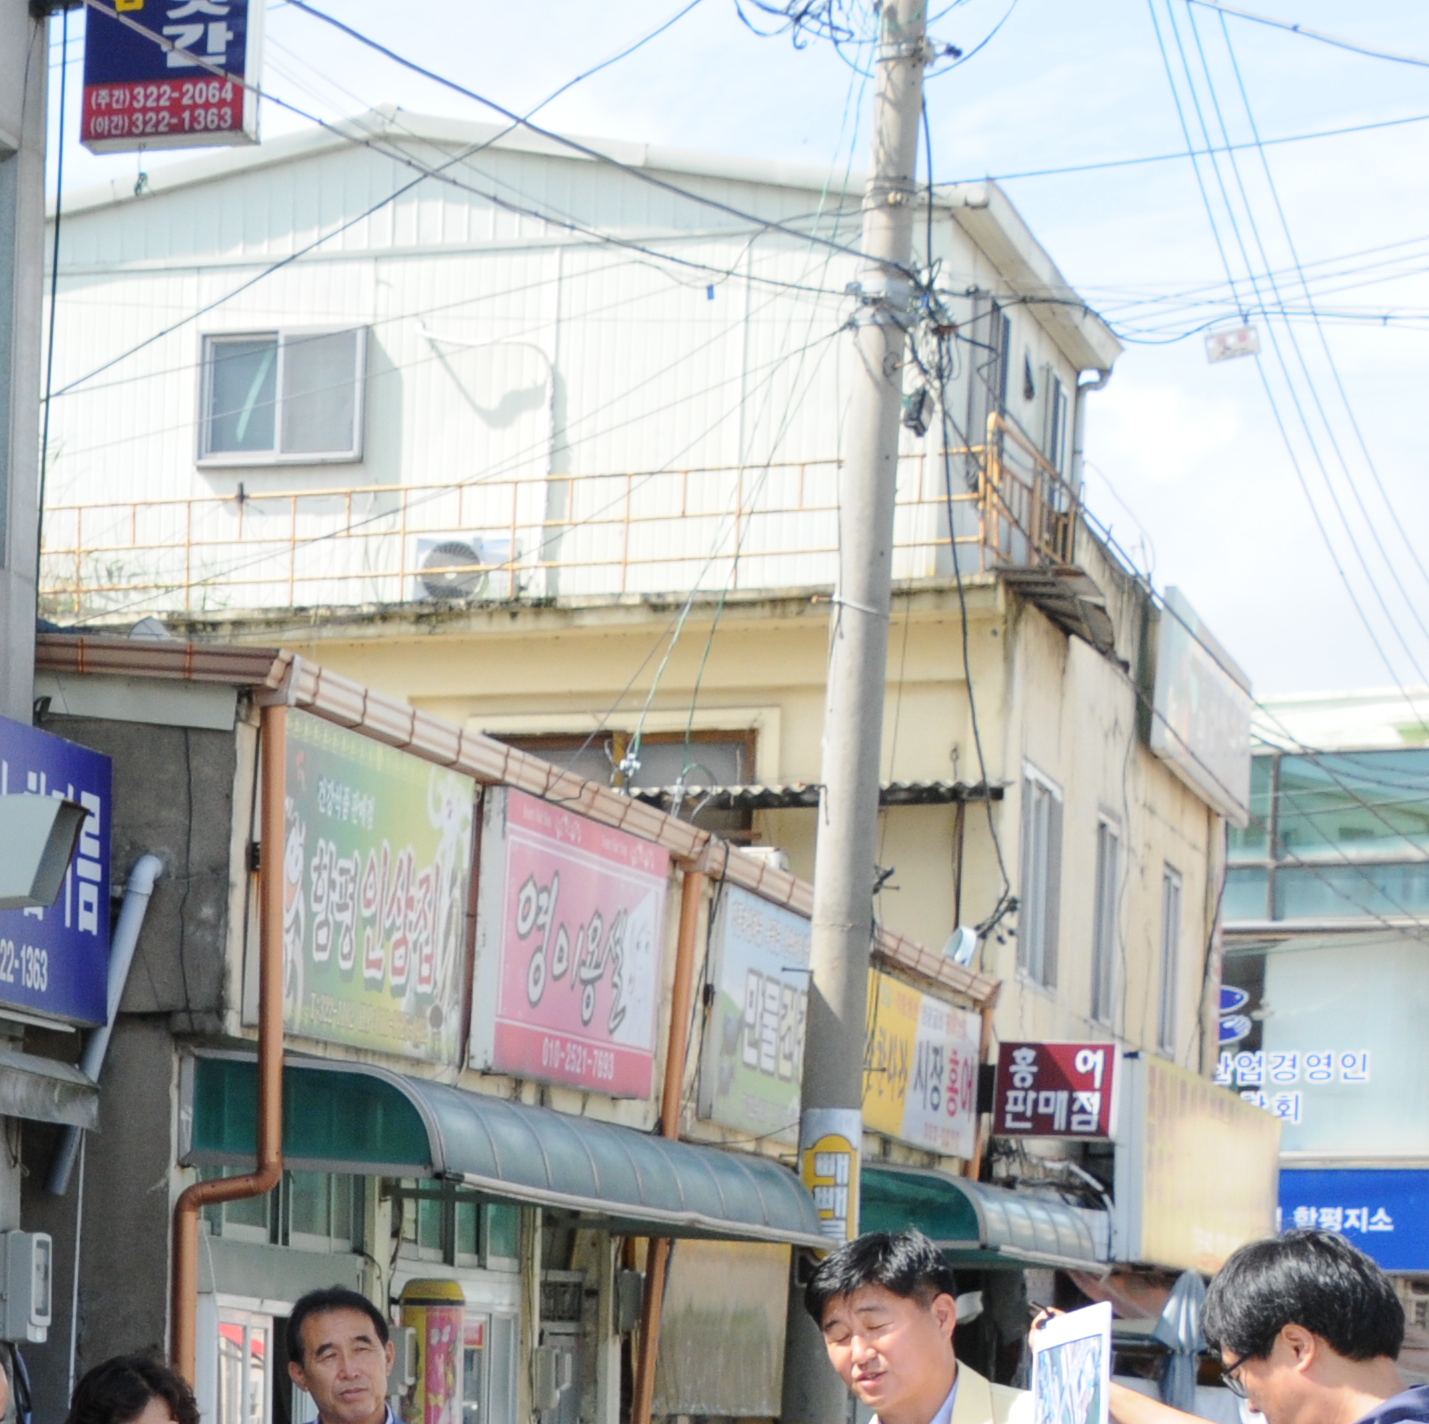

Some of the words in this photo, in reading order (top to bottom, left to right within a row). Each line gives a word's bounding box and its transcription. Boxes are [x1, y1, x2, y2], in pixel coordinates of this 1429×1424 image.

[161, 0, 234, 68] 간
[311, 838, 360, 974] 함평
[1004, 1090, 1102, 1132] 판매점
